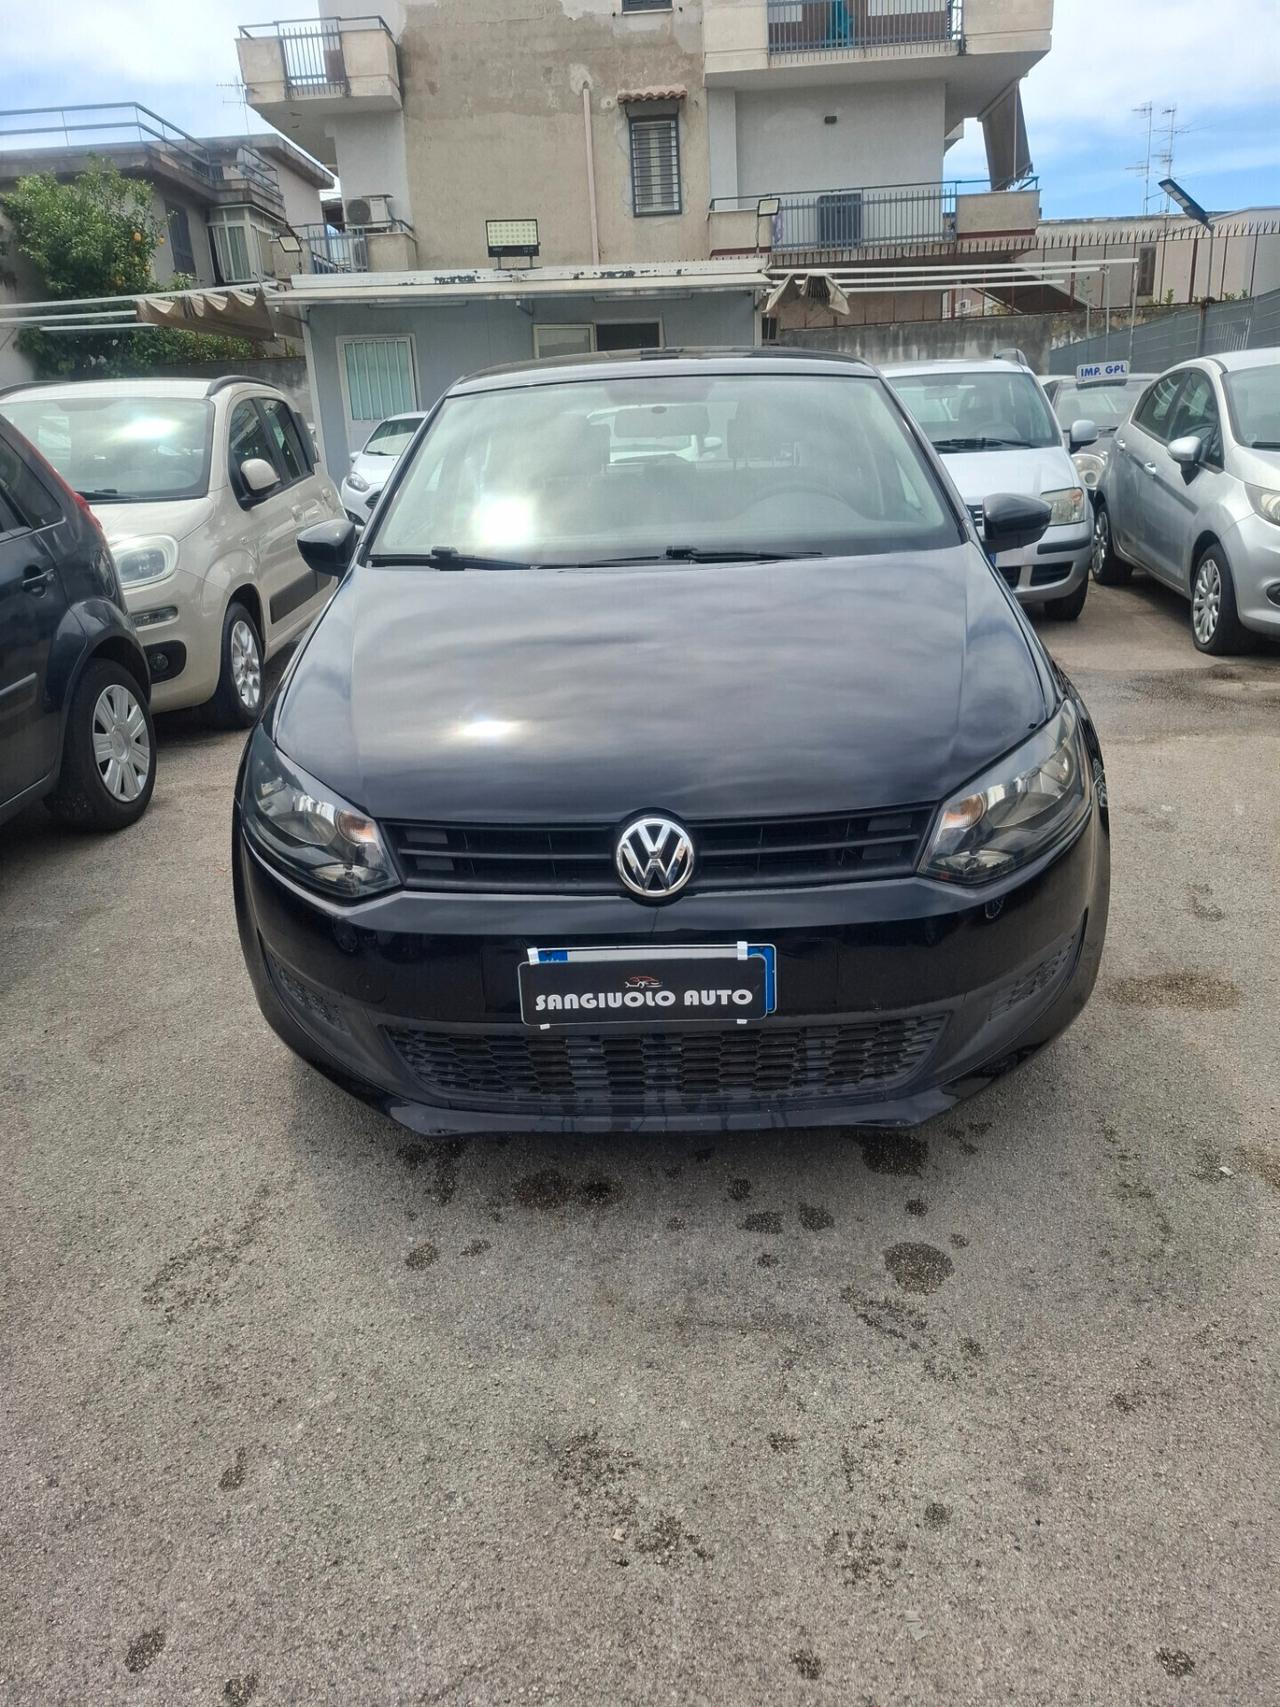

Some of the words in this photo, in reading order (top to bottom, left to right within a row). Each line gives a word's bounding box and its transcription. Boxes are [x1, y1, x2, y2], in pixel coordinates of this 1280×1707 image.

[1080, 366, 1102, 377] IMP.
[1105, 364, 1126, 375] GPL
[618, 819, 692, 895] VW
[535, 990, 676, 1011] SANGIUOLO
[684, 989, 753, 1006] AUTO
